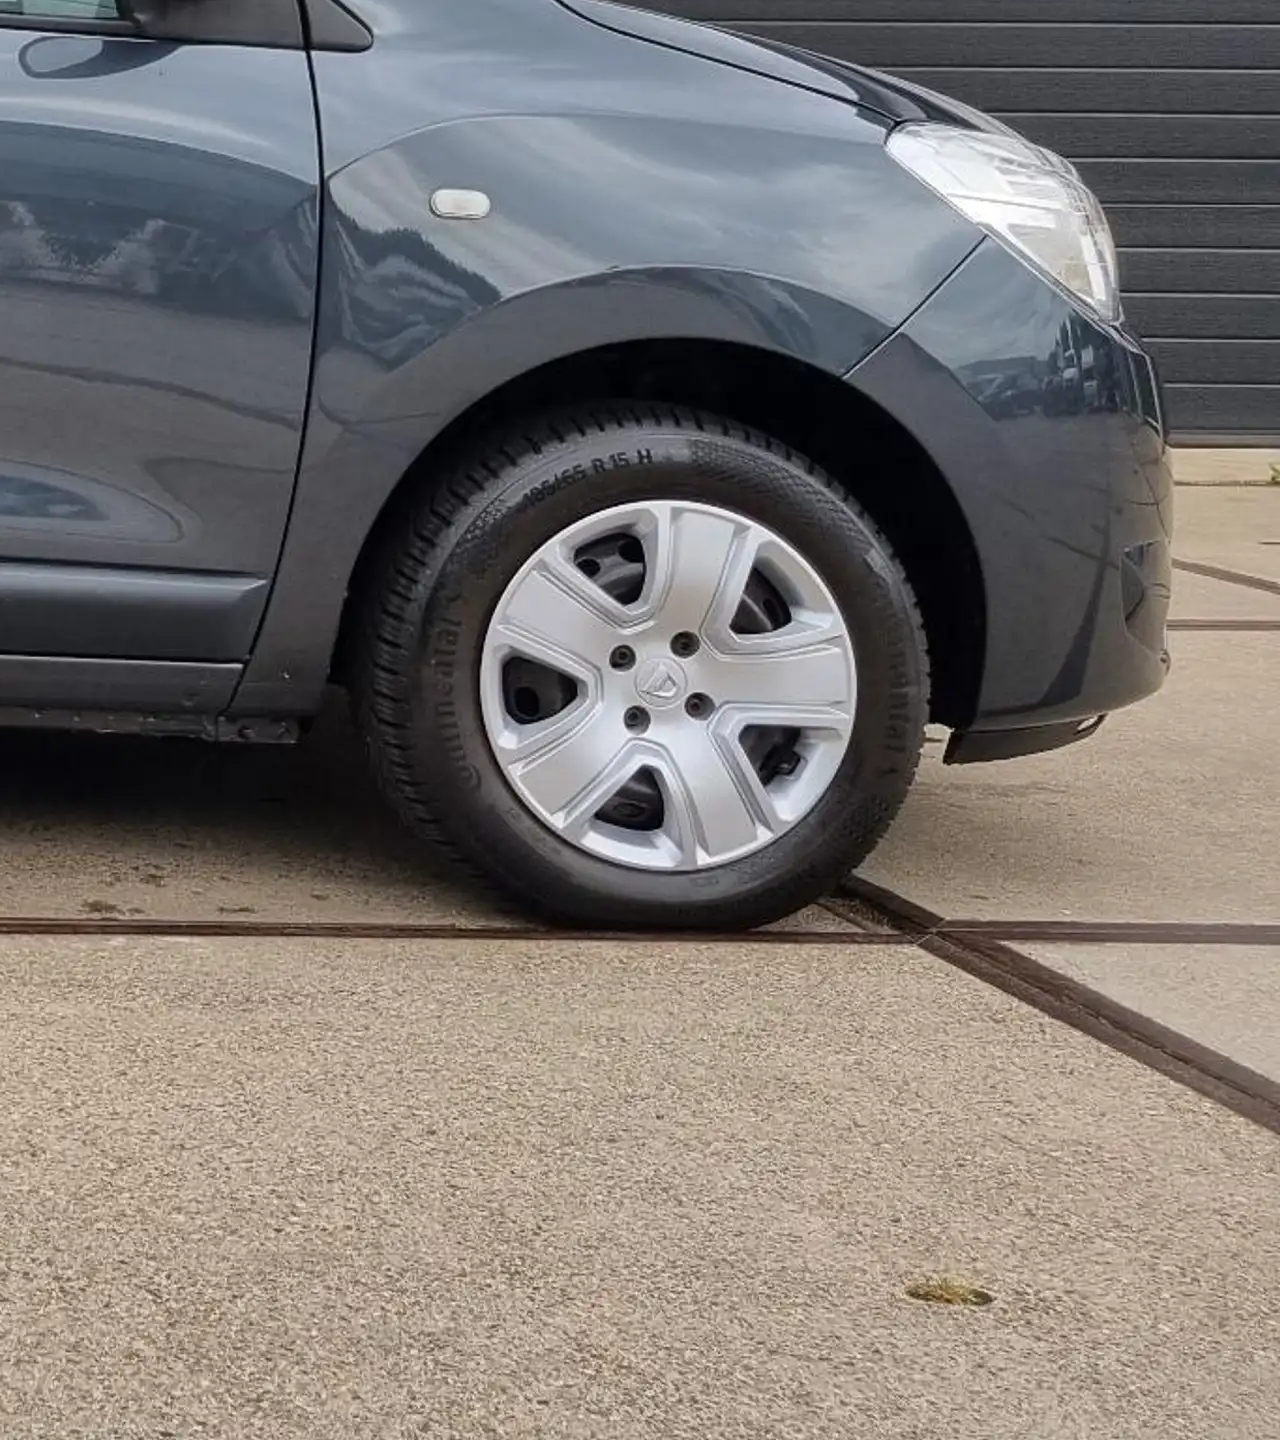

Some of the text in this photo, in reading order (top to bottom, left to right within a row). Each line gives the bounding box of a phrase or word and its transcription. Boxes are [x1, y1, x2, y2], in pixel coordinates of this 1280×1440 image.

[590, 457, 607, 474] R
[609, 451, 631, 469] 15
[636, 448, 654, 464] H
